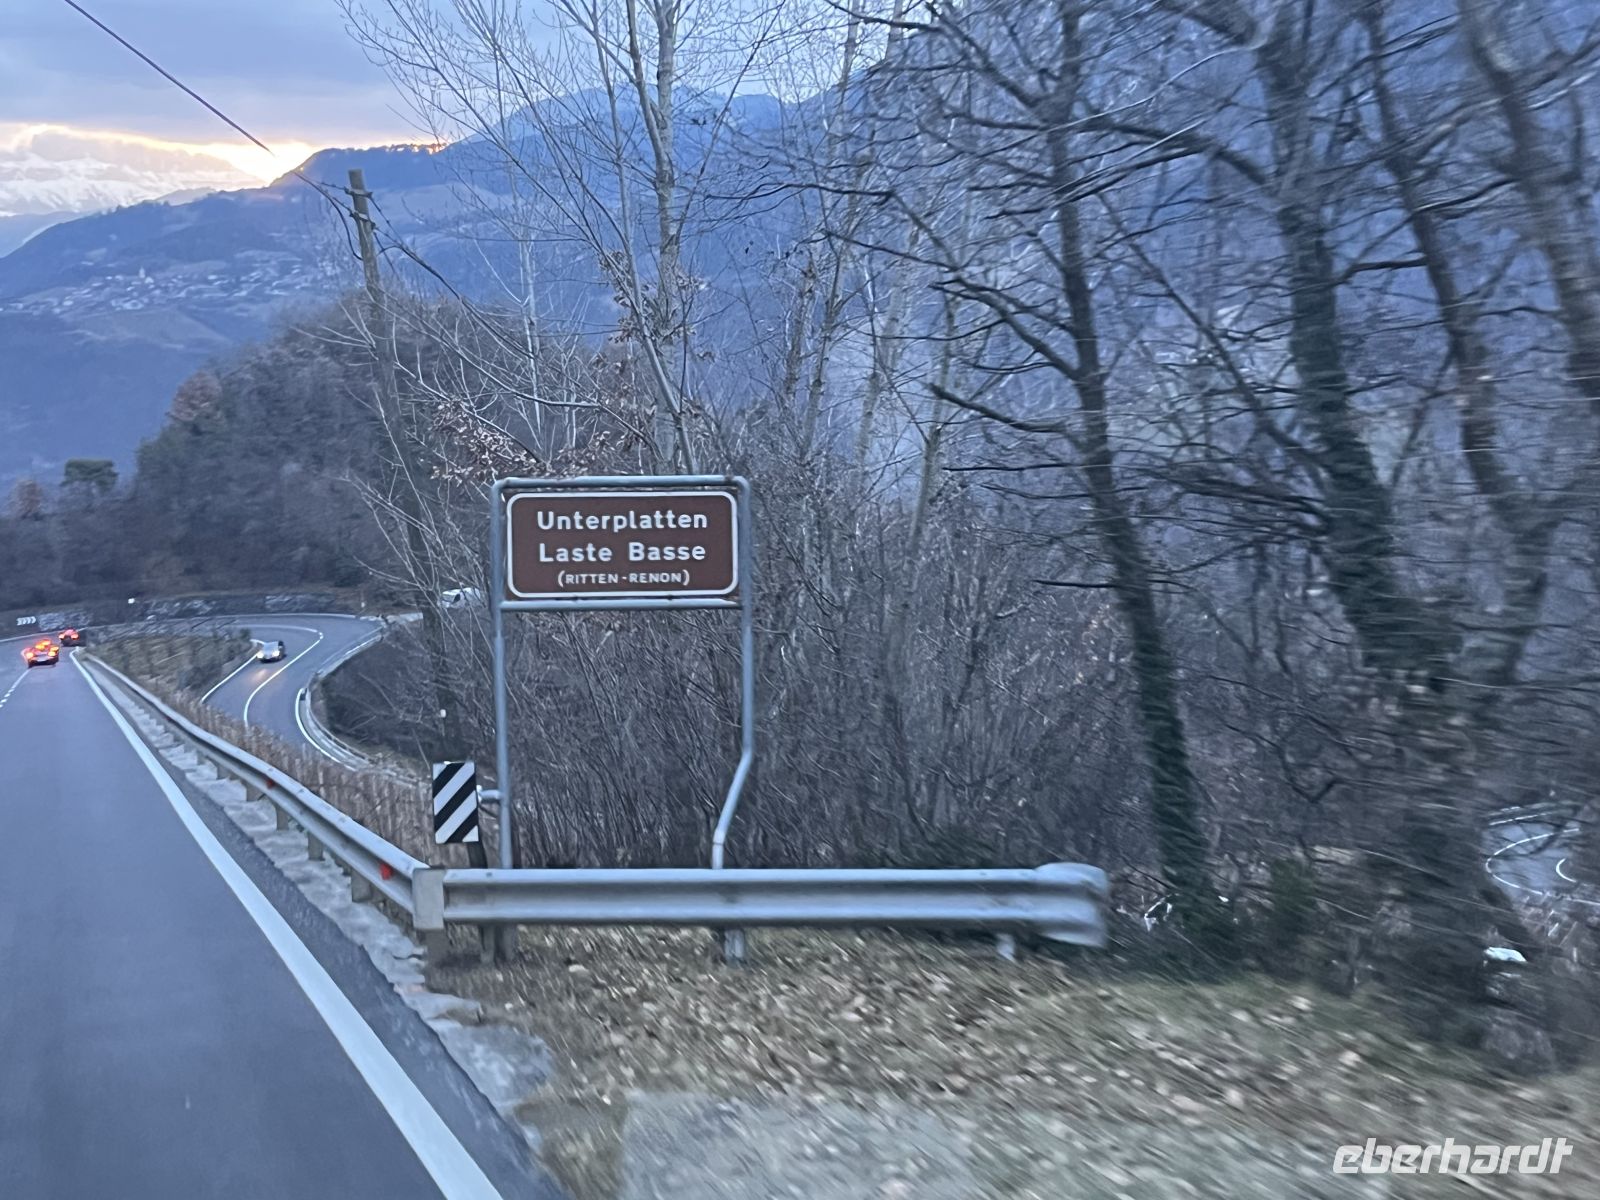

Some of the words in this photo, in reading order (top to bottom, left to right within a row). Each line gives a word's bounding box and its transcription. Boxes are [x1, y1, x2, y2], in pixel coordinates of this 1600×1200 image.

[537, 509, 708, 533] Unterplatten
[539, 542, 613, 562] Laste
[628, 541, 706, 561] Basse
